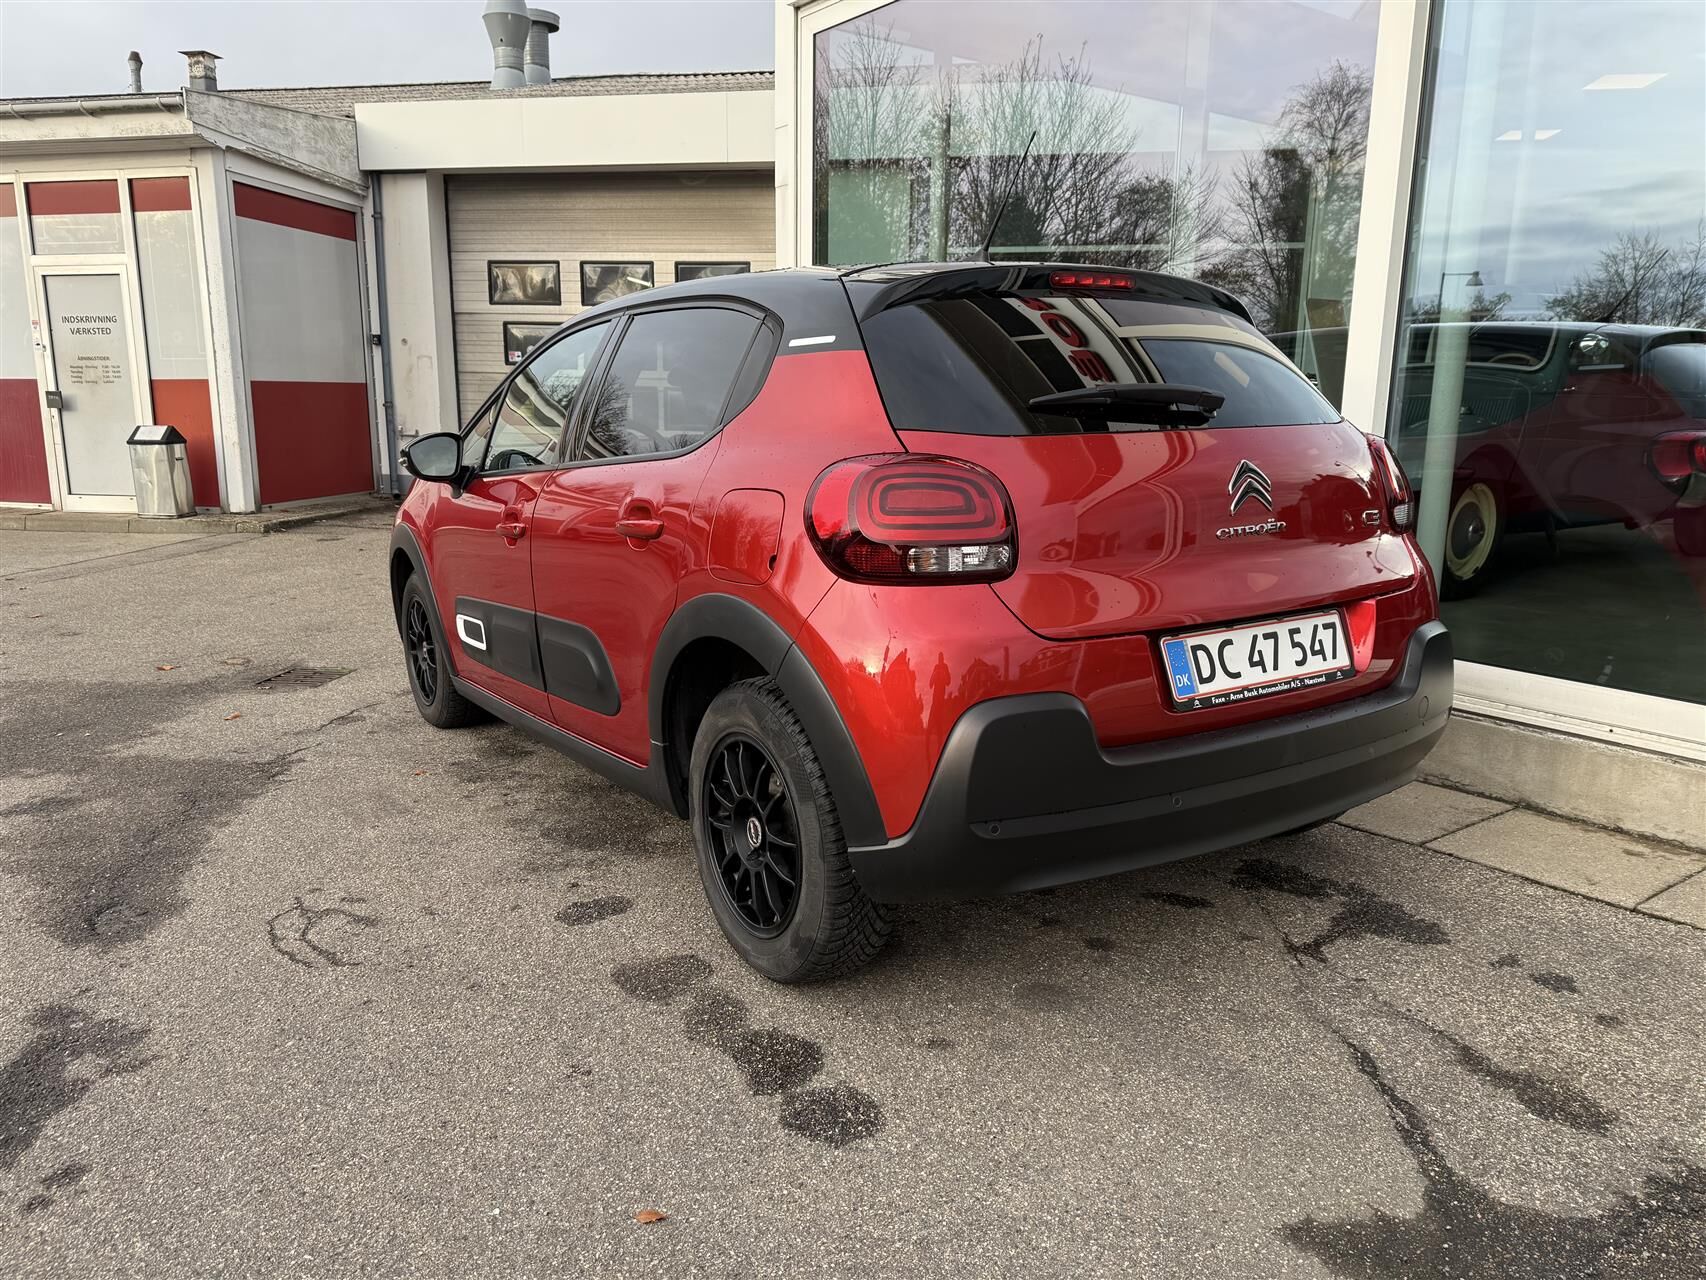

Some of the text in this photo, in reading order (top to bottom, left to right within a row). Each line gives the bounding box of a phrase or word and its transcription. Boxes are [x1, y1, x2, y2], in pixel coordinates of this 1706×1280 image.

[61, 315, 118, 324] INDSKRIVNING
[69, 327, 112, 335] VÆRKSTED
[1362, 509, 1380, 526] C3
[1215, 518, 1287, 540] CITROËN
[1190, 621, 1338, 685] DC 47 547
[1176, 673, 1191, 688] DK
[1211, 696, 1226, 704] Faxe
[1230, 693, 1244, 701] Arne
[1244, 689, 1258, 698] Busk
[1259, 683, 1291, 695] Automobiler
[1291, 679, 1302, 689] A/S
